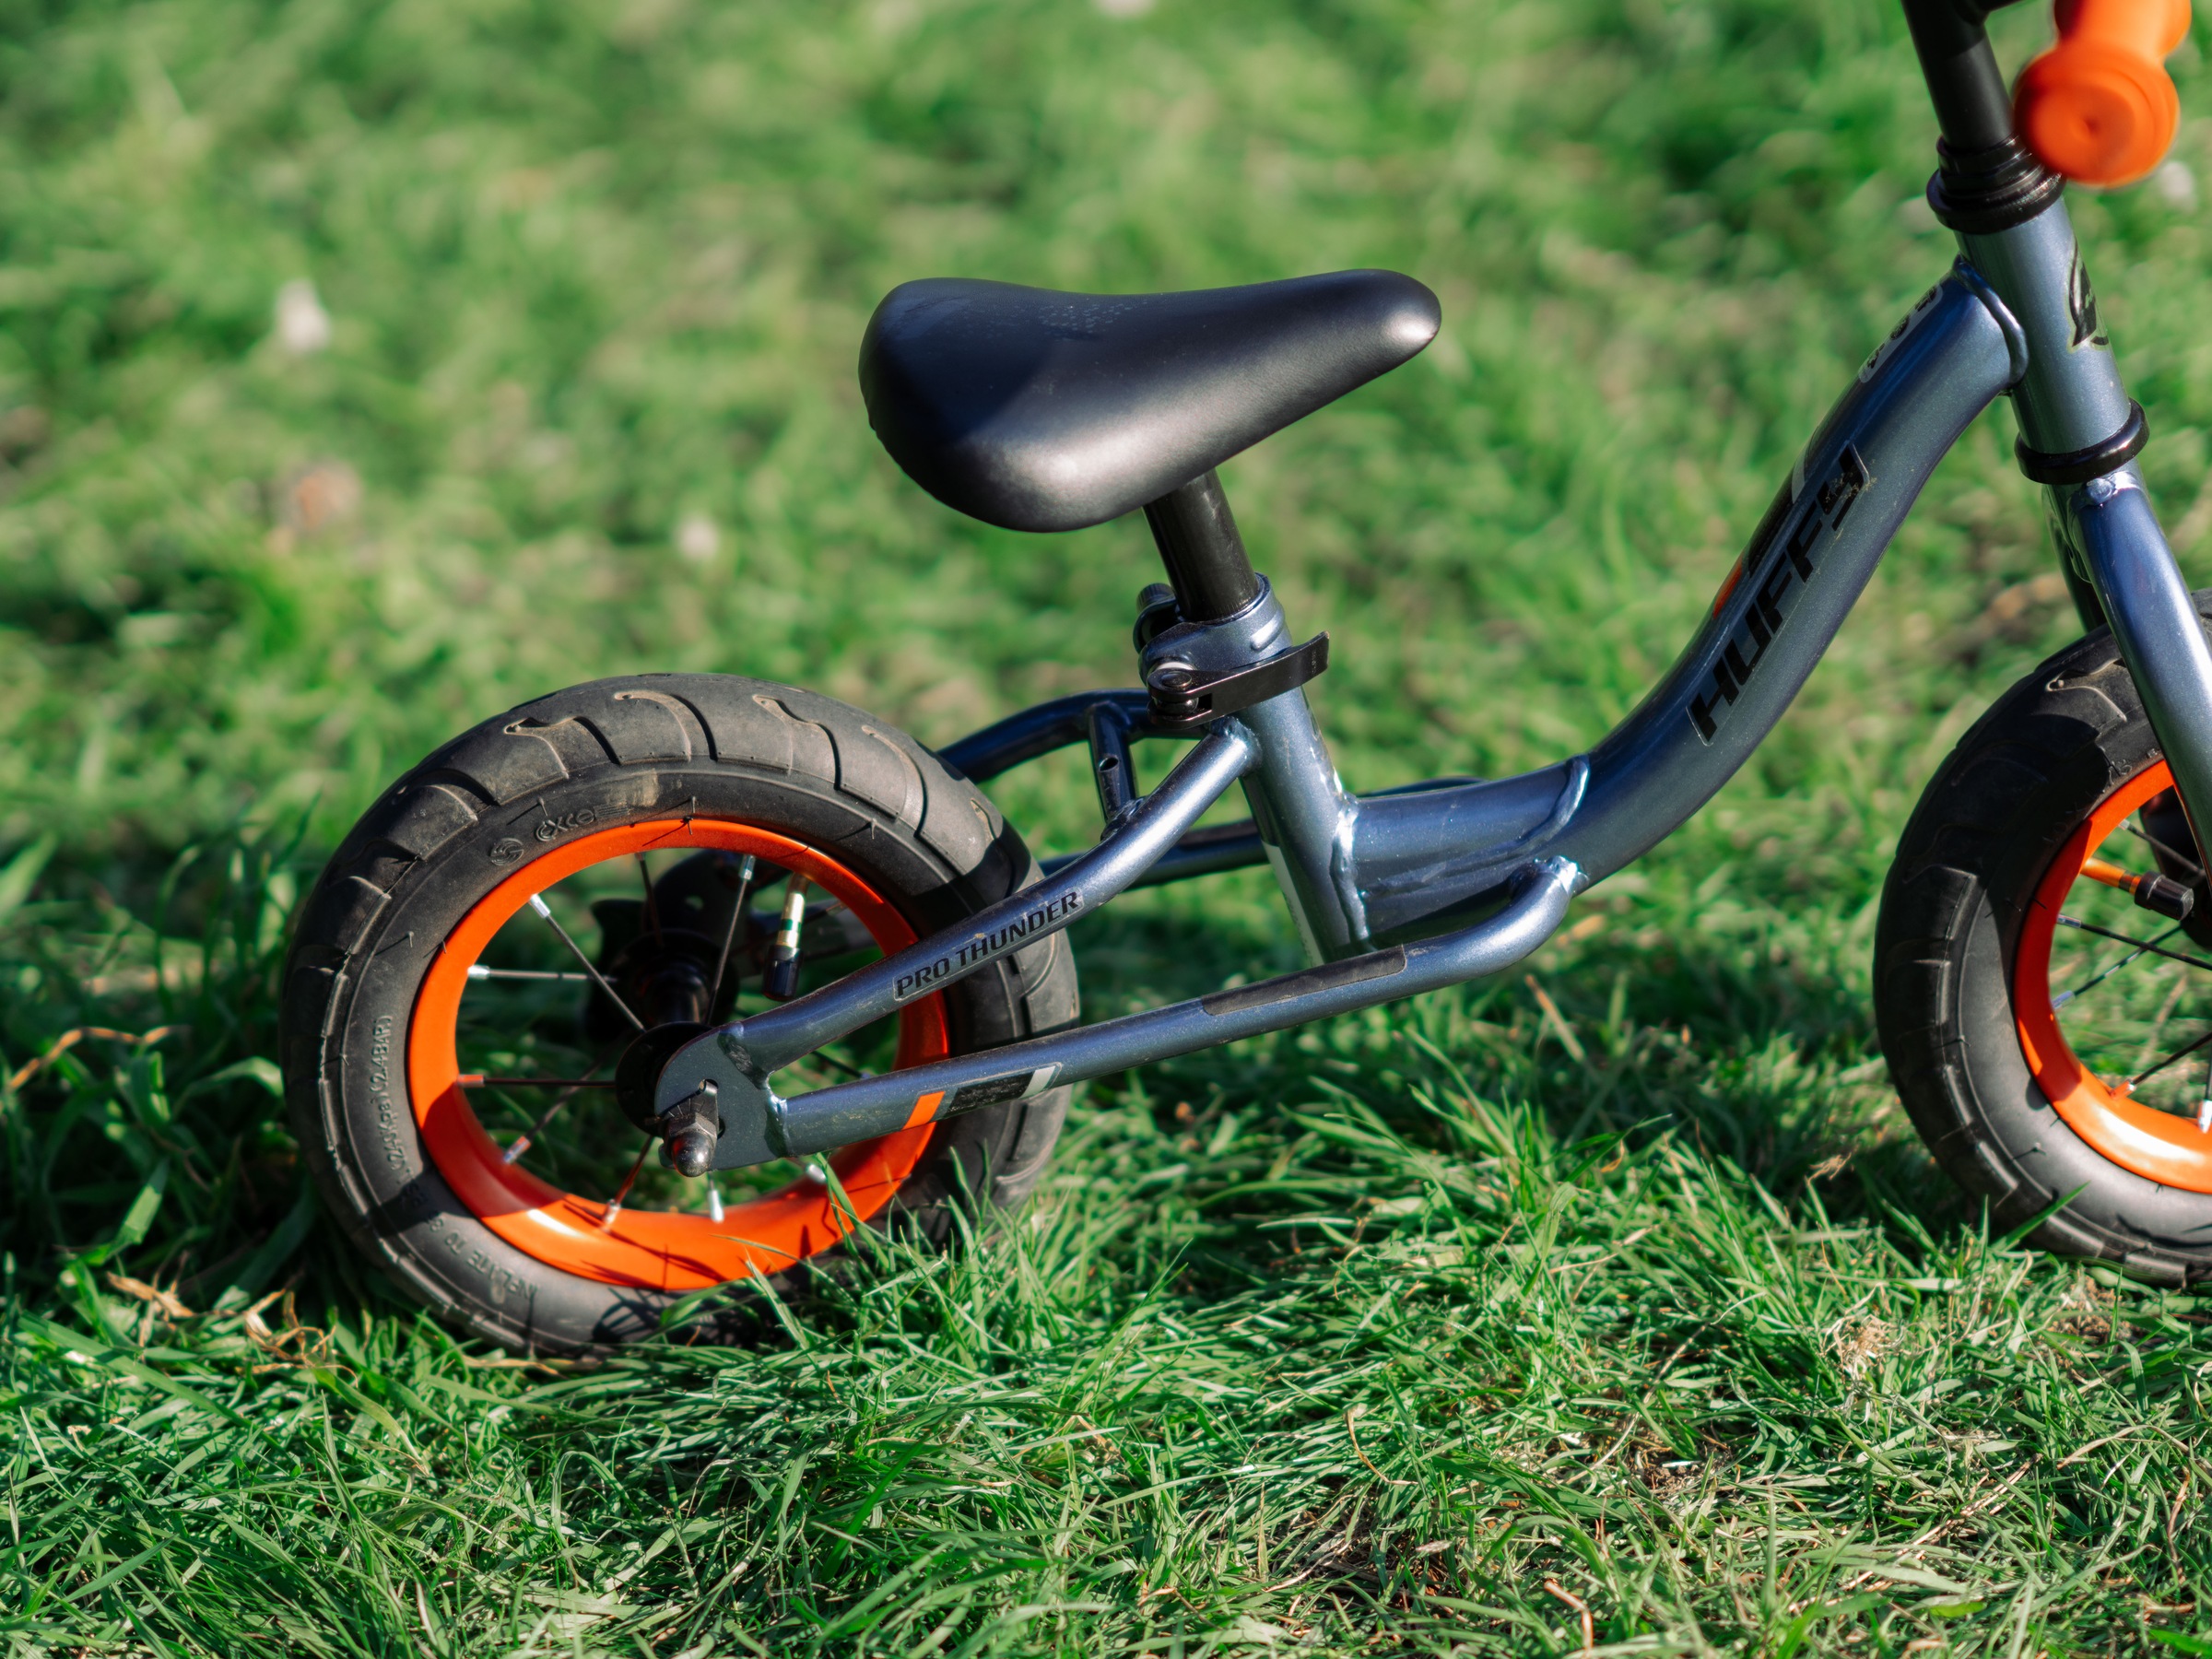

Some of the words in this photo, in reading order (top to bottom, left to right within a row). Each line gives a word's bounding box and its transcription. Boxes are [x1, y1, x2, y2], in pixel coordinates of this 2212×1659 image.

[1690, 445, 1865, 742] HUFFY
[897, 958, 950, 996] PRO
[956, 891, 1079, 967] THUNDER
[444, 1231, 464, 1255] TO
